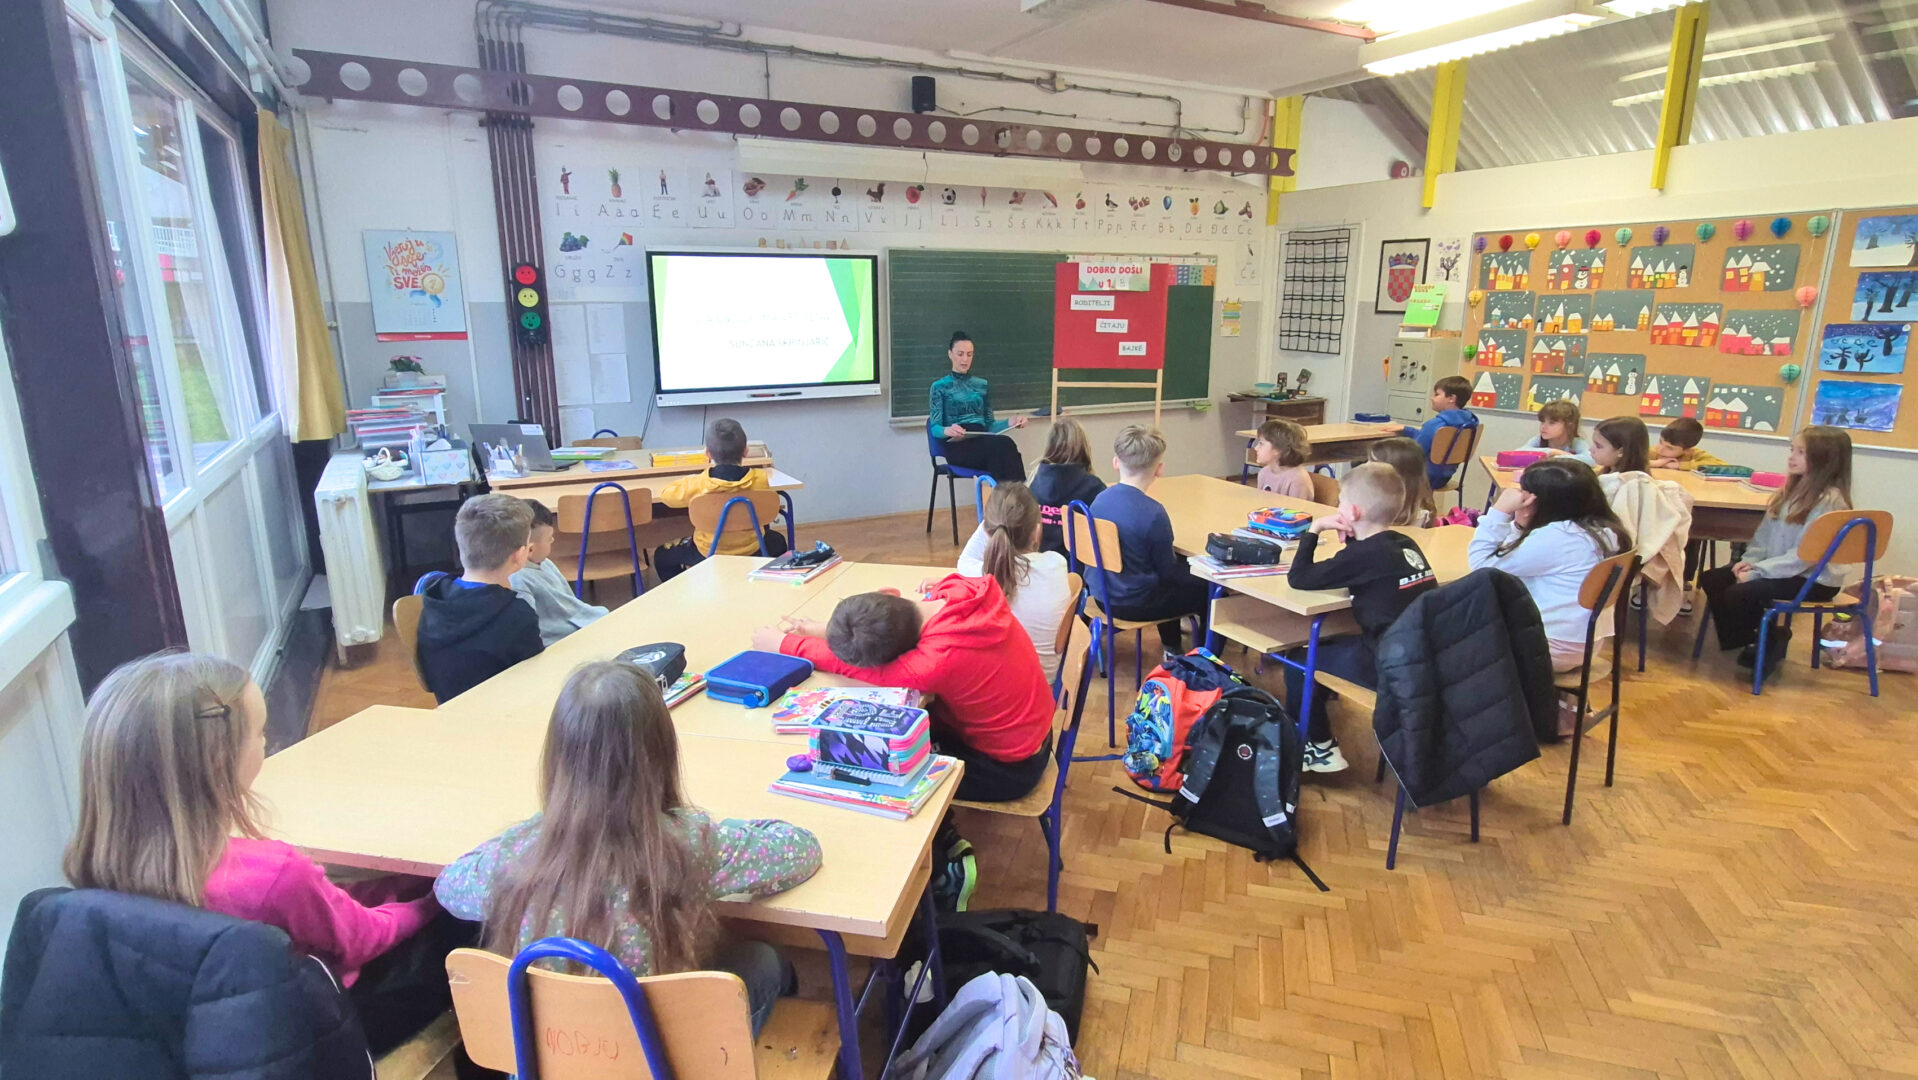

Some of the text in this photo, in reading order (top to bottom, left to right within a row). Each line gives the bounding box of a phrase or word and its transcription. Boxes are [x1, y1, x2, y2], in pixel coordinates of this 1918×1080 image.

[598, 203, 610, 217] A
[616, 208, 625, 218] a
[652, 203, 681, 219] E e
[698, 205, 727, 219] U u
[743, 207, 768, 220] O o
[783, 209, 813, 222] M m
[826, 210, 850, 223] N n
[865, 211, 873, 223] V
[974, 215, 981, 227] S
[1072, 217, 1079, 229] T
[1036, 218, 1043, 229] K
[1098, 218, 1104, 229] P
[1130, 220, 1137, 231] R
[1159, 222, 1175, 233] B b
[1185, 222, 1202, 233] D d
[555, 264, 566, 278] G
[573, 269, 581, 283] g
[606, 264, 633, 278] Z z
[1086, 264, 1143, 274] DOBRO DOŠLI
[1098, 280, 1104, 288] u
[1074, 299, 1111, 307] RODITELJI
[1099, 321, 1125, 329] ČITAJU
[1122, 344, 1144, 352] BAJKE
